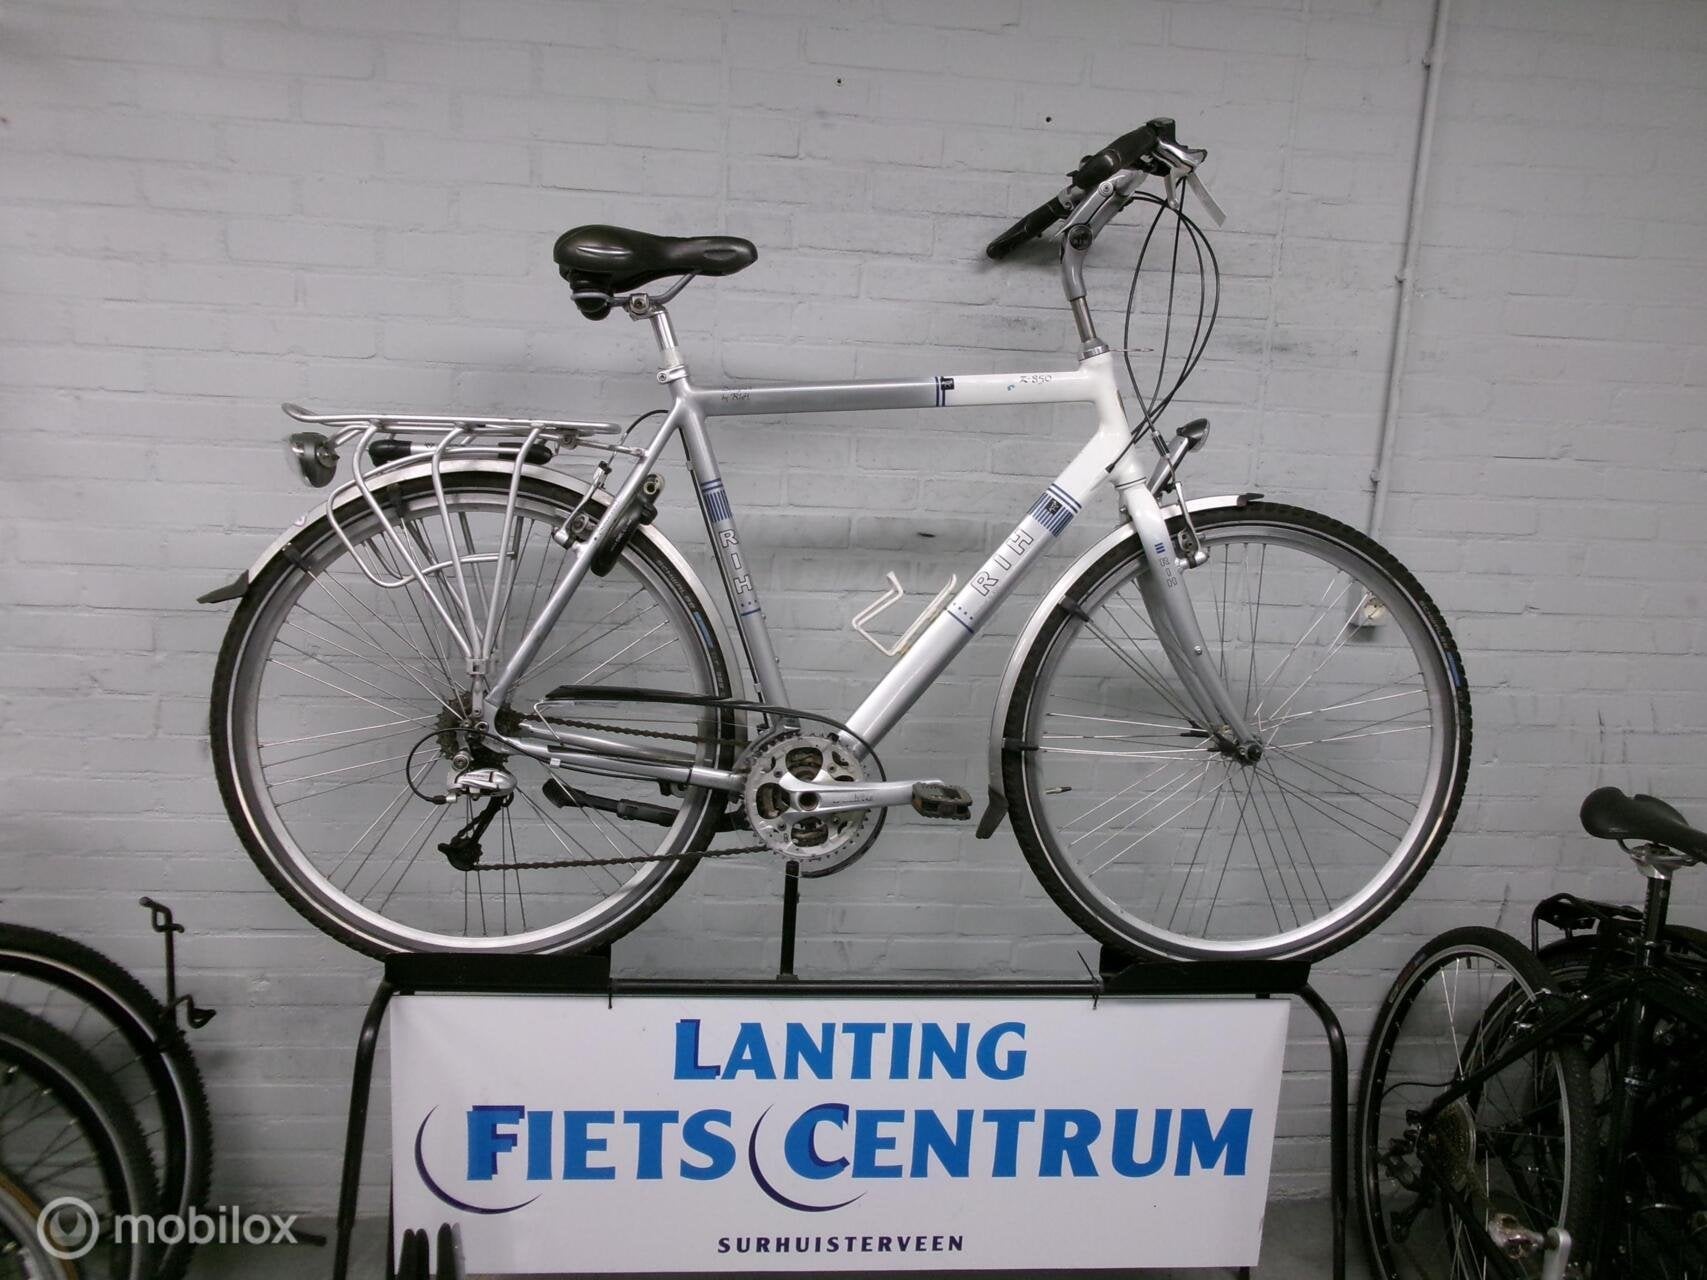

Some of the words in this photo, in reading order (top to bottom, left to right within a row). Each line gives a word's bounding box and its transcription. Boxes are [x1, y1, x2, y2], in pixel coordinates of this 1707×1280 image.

[719, 529, 753, 594] RIH
[970, 528, 1034, 597] RIH
[673, 1018, 1027, 1080] LANTING
[466, 1105, 737, 1181] FIETS
[784, 1103, 1253, 1180] CENTRUM
[717, 1235, 965, 1254] SURHUISTERVEEN
